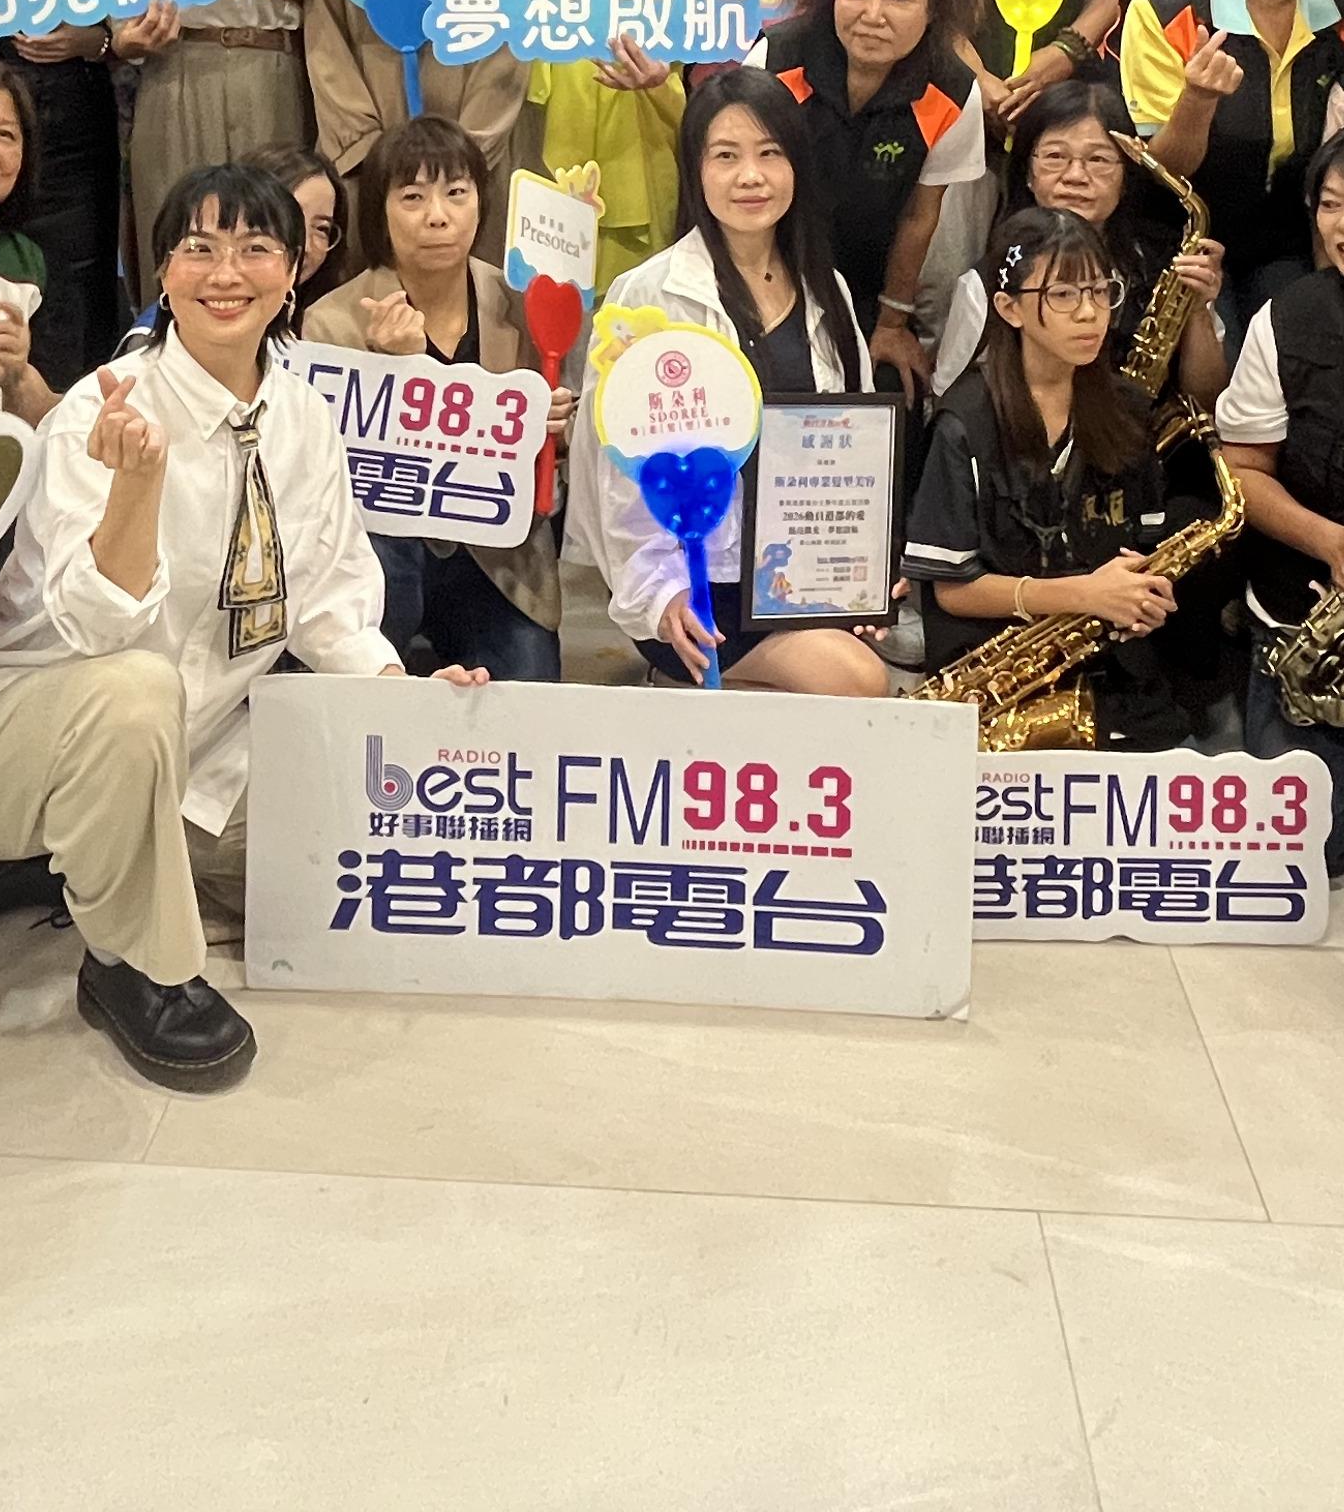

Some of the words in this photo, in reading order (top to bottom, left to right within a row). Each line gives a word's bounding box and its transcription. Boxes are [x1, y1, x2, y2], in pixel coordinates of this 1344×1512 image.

[520, 215, 580, 259] Presotea
[399, 377, 528, 445] 98.3
[346, 447, 516, 526] 電台
[436, 747, 502, 765] RADIO
[981, 772, 1031, 784] RADIO
[365, 734, 534, 817] best
[556, 755, 671, 847] FM
[682, 759, 853, 839] 98.3
[975, 773, 1055, 822] est
[1063, 774, 1158, 847] FM
[1168, 774, 1309, 837] 98.3
[368, 812, 534, 843] 好事聯播網
[975, 825, 1056, 847] 聯播網
[328, 848, 888, 957] 港都電台
